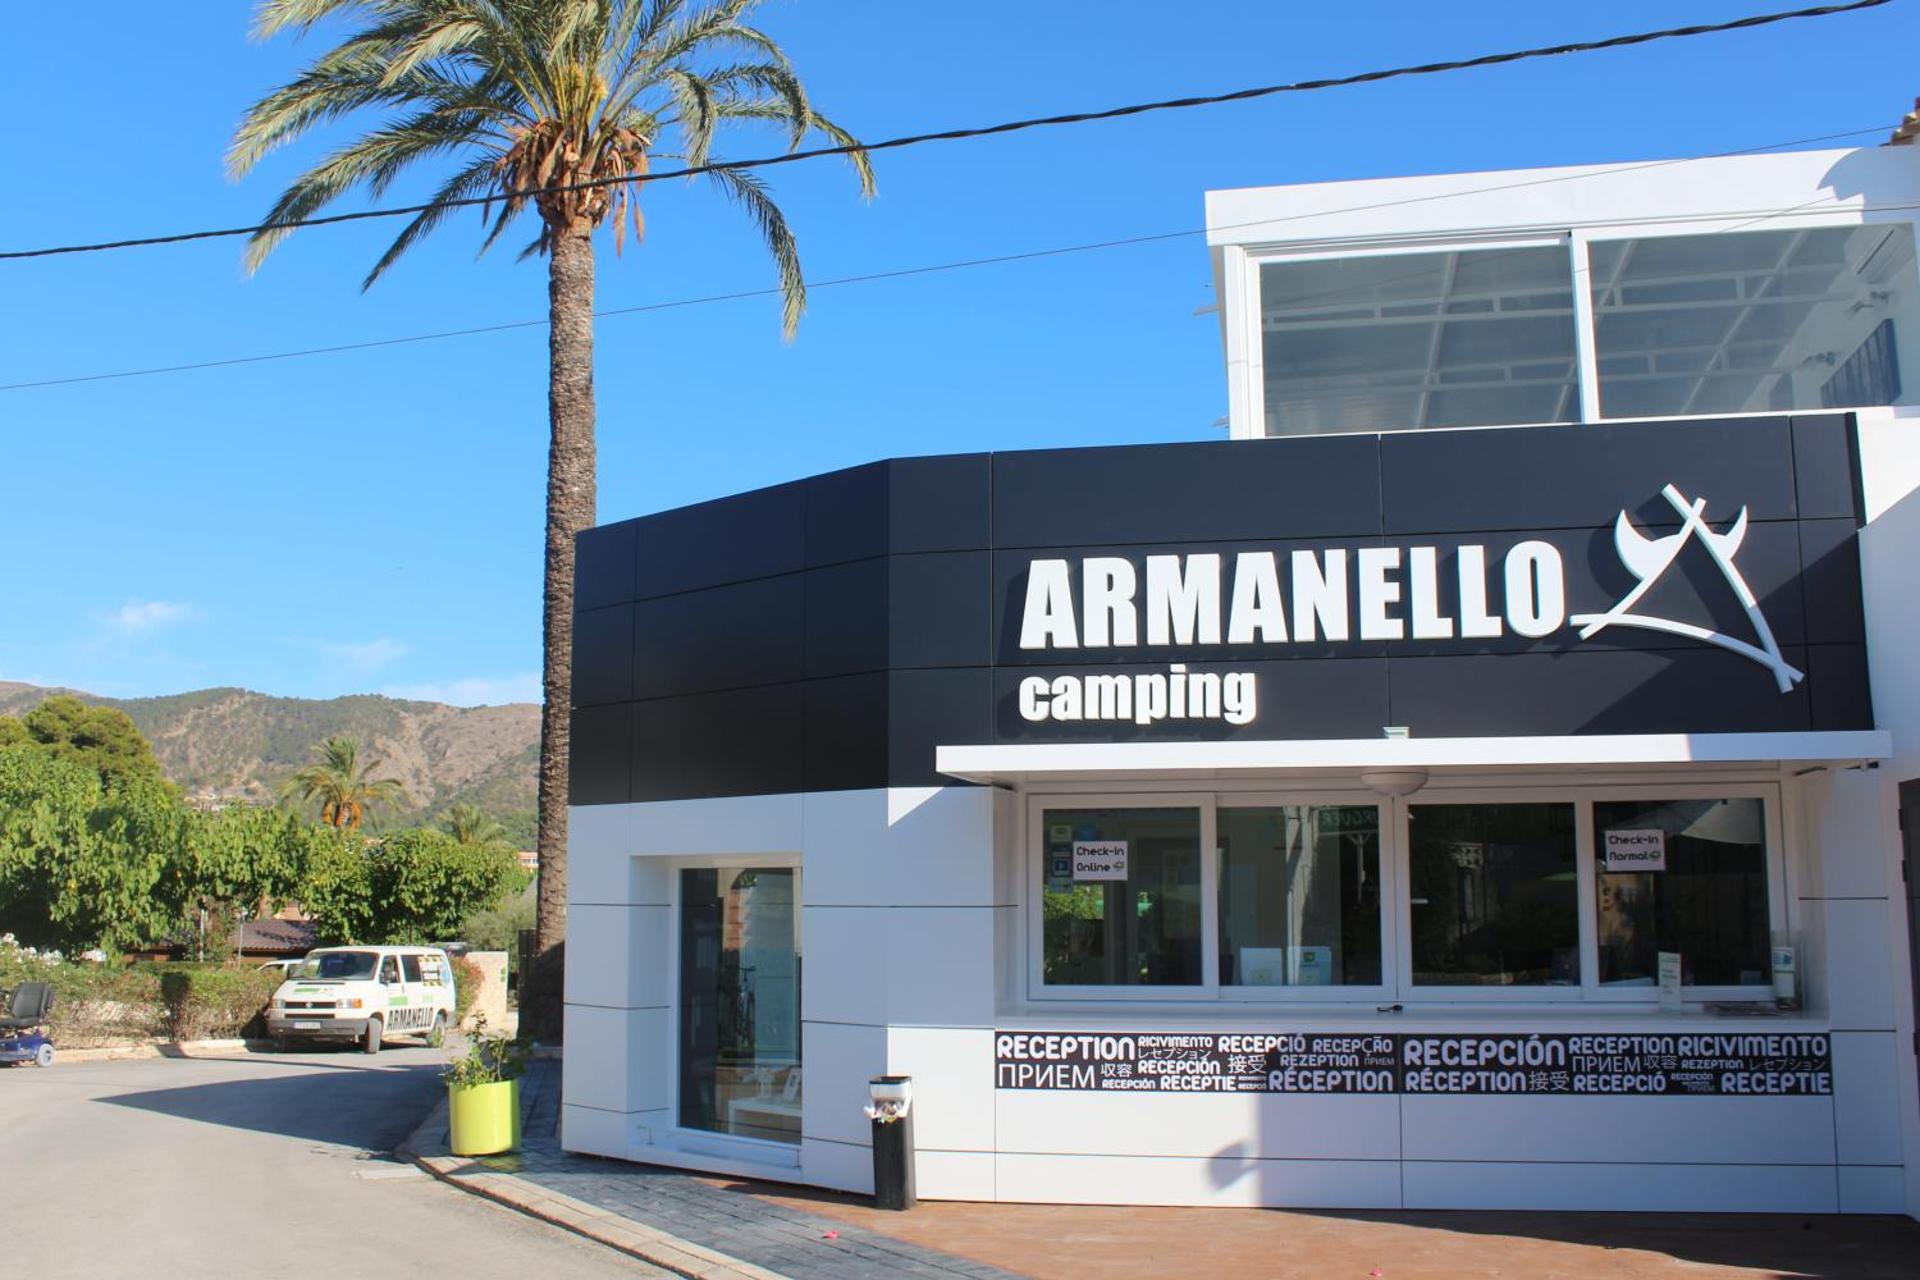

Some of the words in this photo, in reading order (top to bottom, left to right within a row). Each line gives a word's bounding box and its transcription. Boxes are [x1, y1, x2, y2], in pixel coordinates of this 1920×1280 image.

[1019, 540, 1565, 649] ARMANELLO
[1019, 664, 1257, 725] camping
[1076, 862, 1110, 873] Online
[387, 1007, 433, 1031] ARMANELLO
[997, 1035, 1135, 1060] RECEPTION
[1137, 1036, 1213, 1048] RICIVIMENTO
[1403, 1034, 1565, 1066] RECEPCIÓN
[1568, 1037, 1674, 1055] RECEPTION
[1678, 1036, 1828, 1056] RICIVIMENTO
[1227, 1053, 1266, 1074] 接受
[1280, 1054, 1359, 1067] REZEPTION
[1572, 1056, 1641, 1073] ПРИЕМ
[1681, 1059, 1744, 1070] REZEPTION
[998, 1063, 1096, 1088] ПРИЕМ
[1160, 1075, 1237, 1091] RECEPTIE
[1528, 1071, 1570, 1091] 接受
[1721, 1072, 1831, 1093] RECEPTIE
